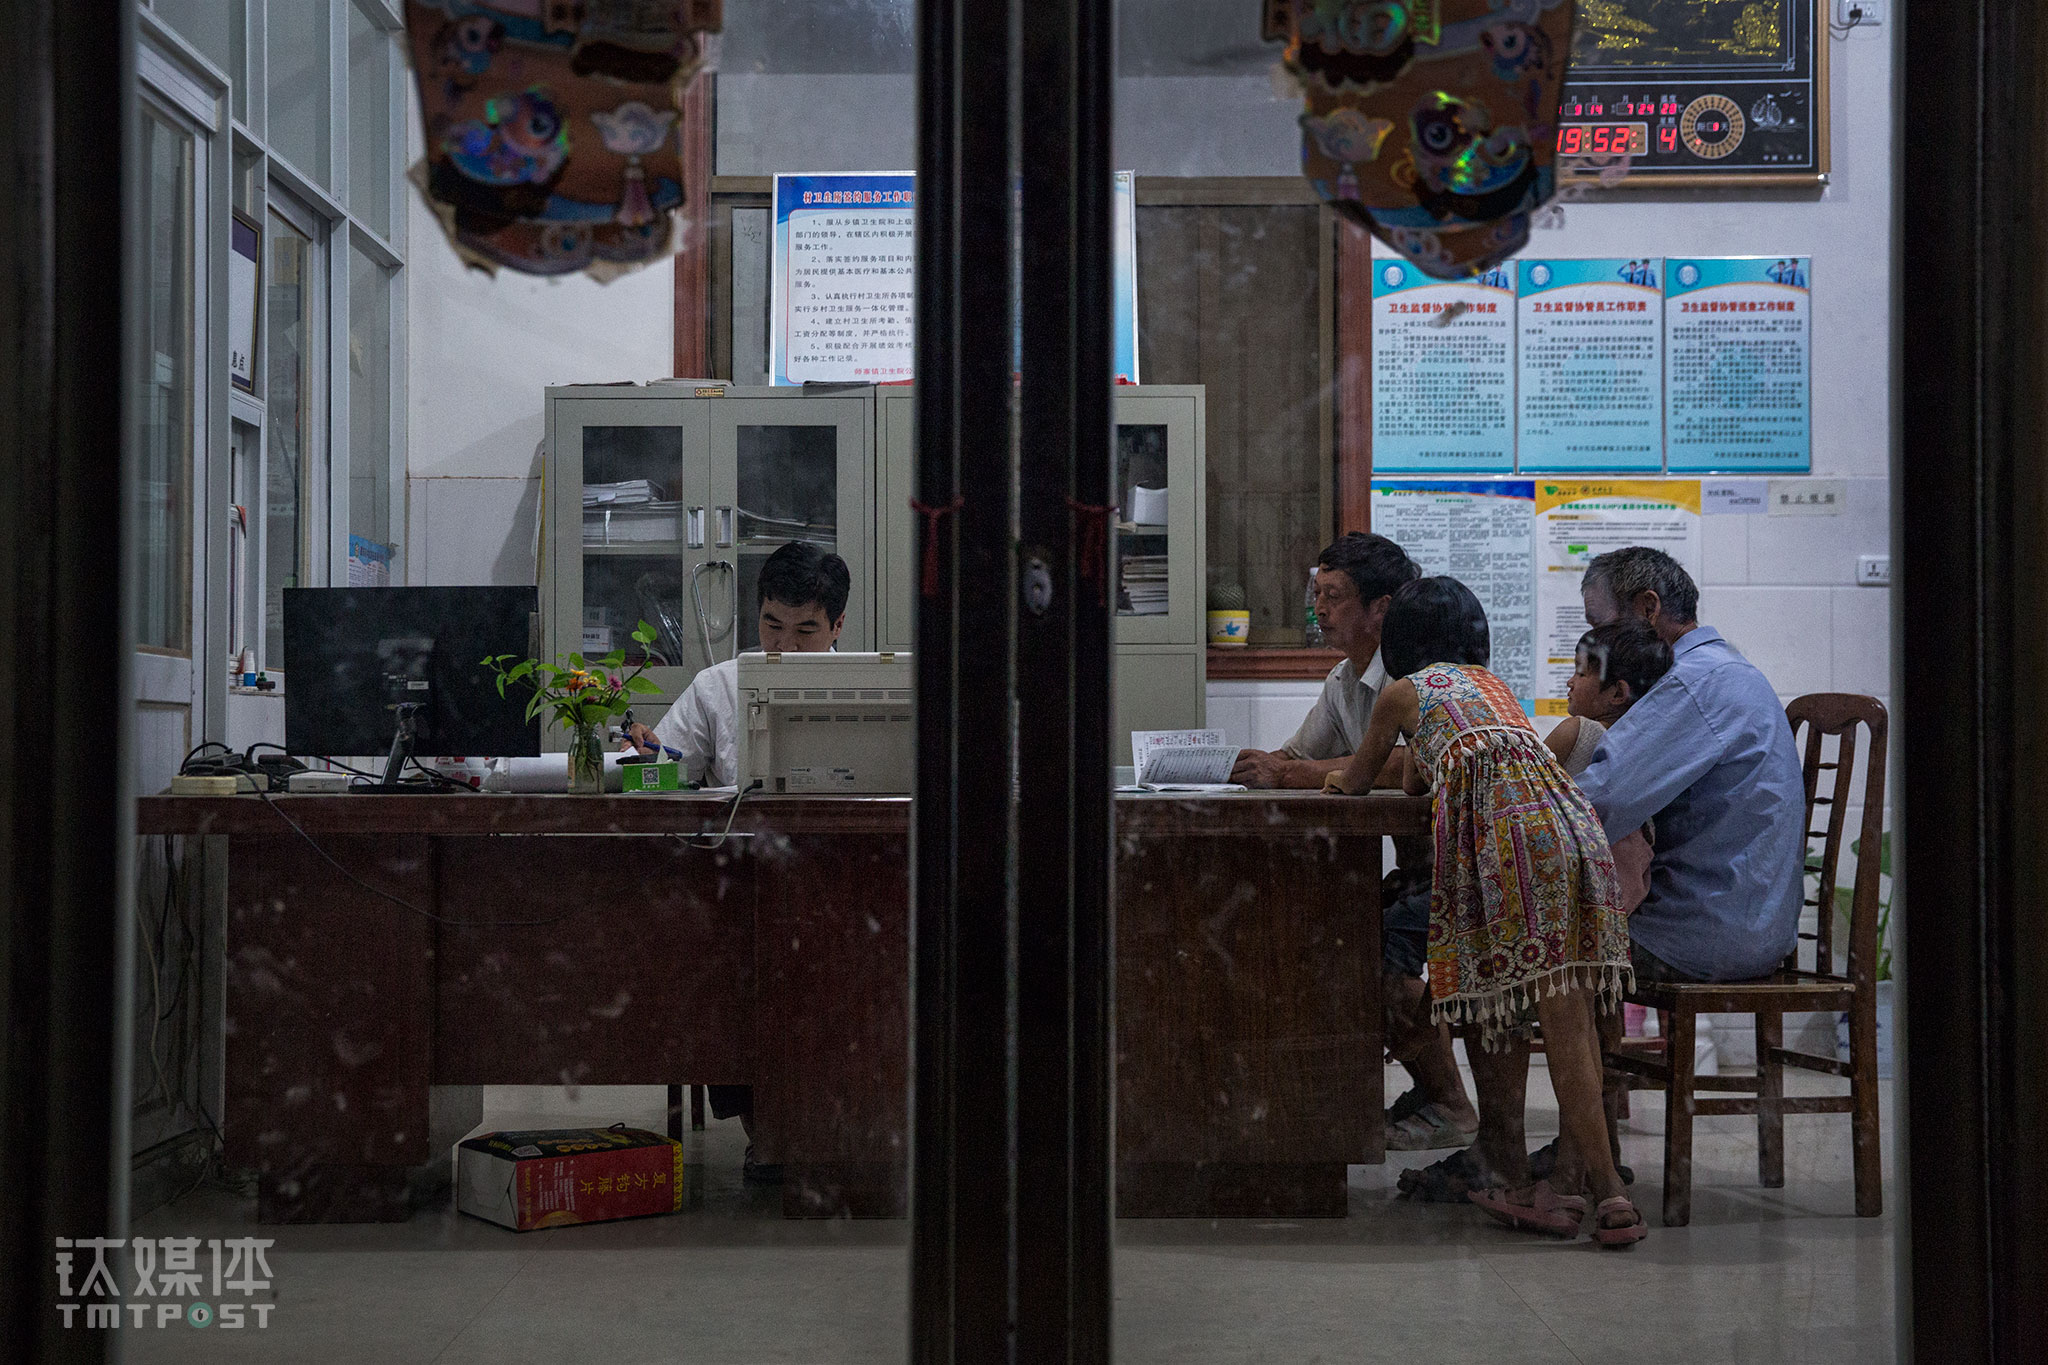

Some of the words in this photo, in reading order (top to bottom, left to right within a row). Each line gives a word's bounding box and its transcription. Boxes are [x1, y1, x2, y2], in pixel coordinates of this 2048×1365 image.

[1661, 128, 1677, 151] 4
[803, 190, 917, 203] 村卫生所签约服务工作职
[1388, 302, 1498, 314] 卫生监督协管作制度
[1532, 300, 1648, 313] 卫生监督协管员工作职责
